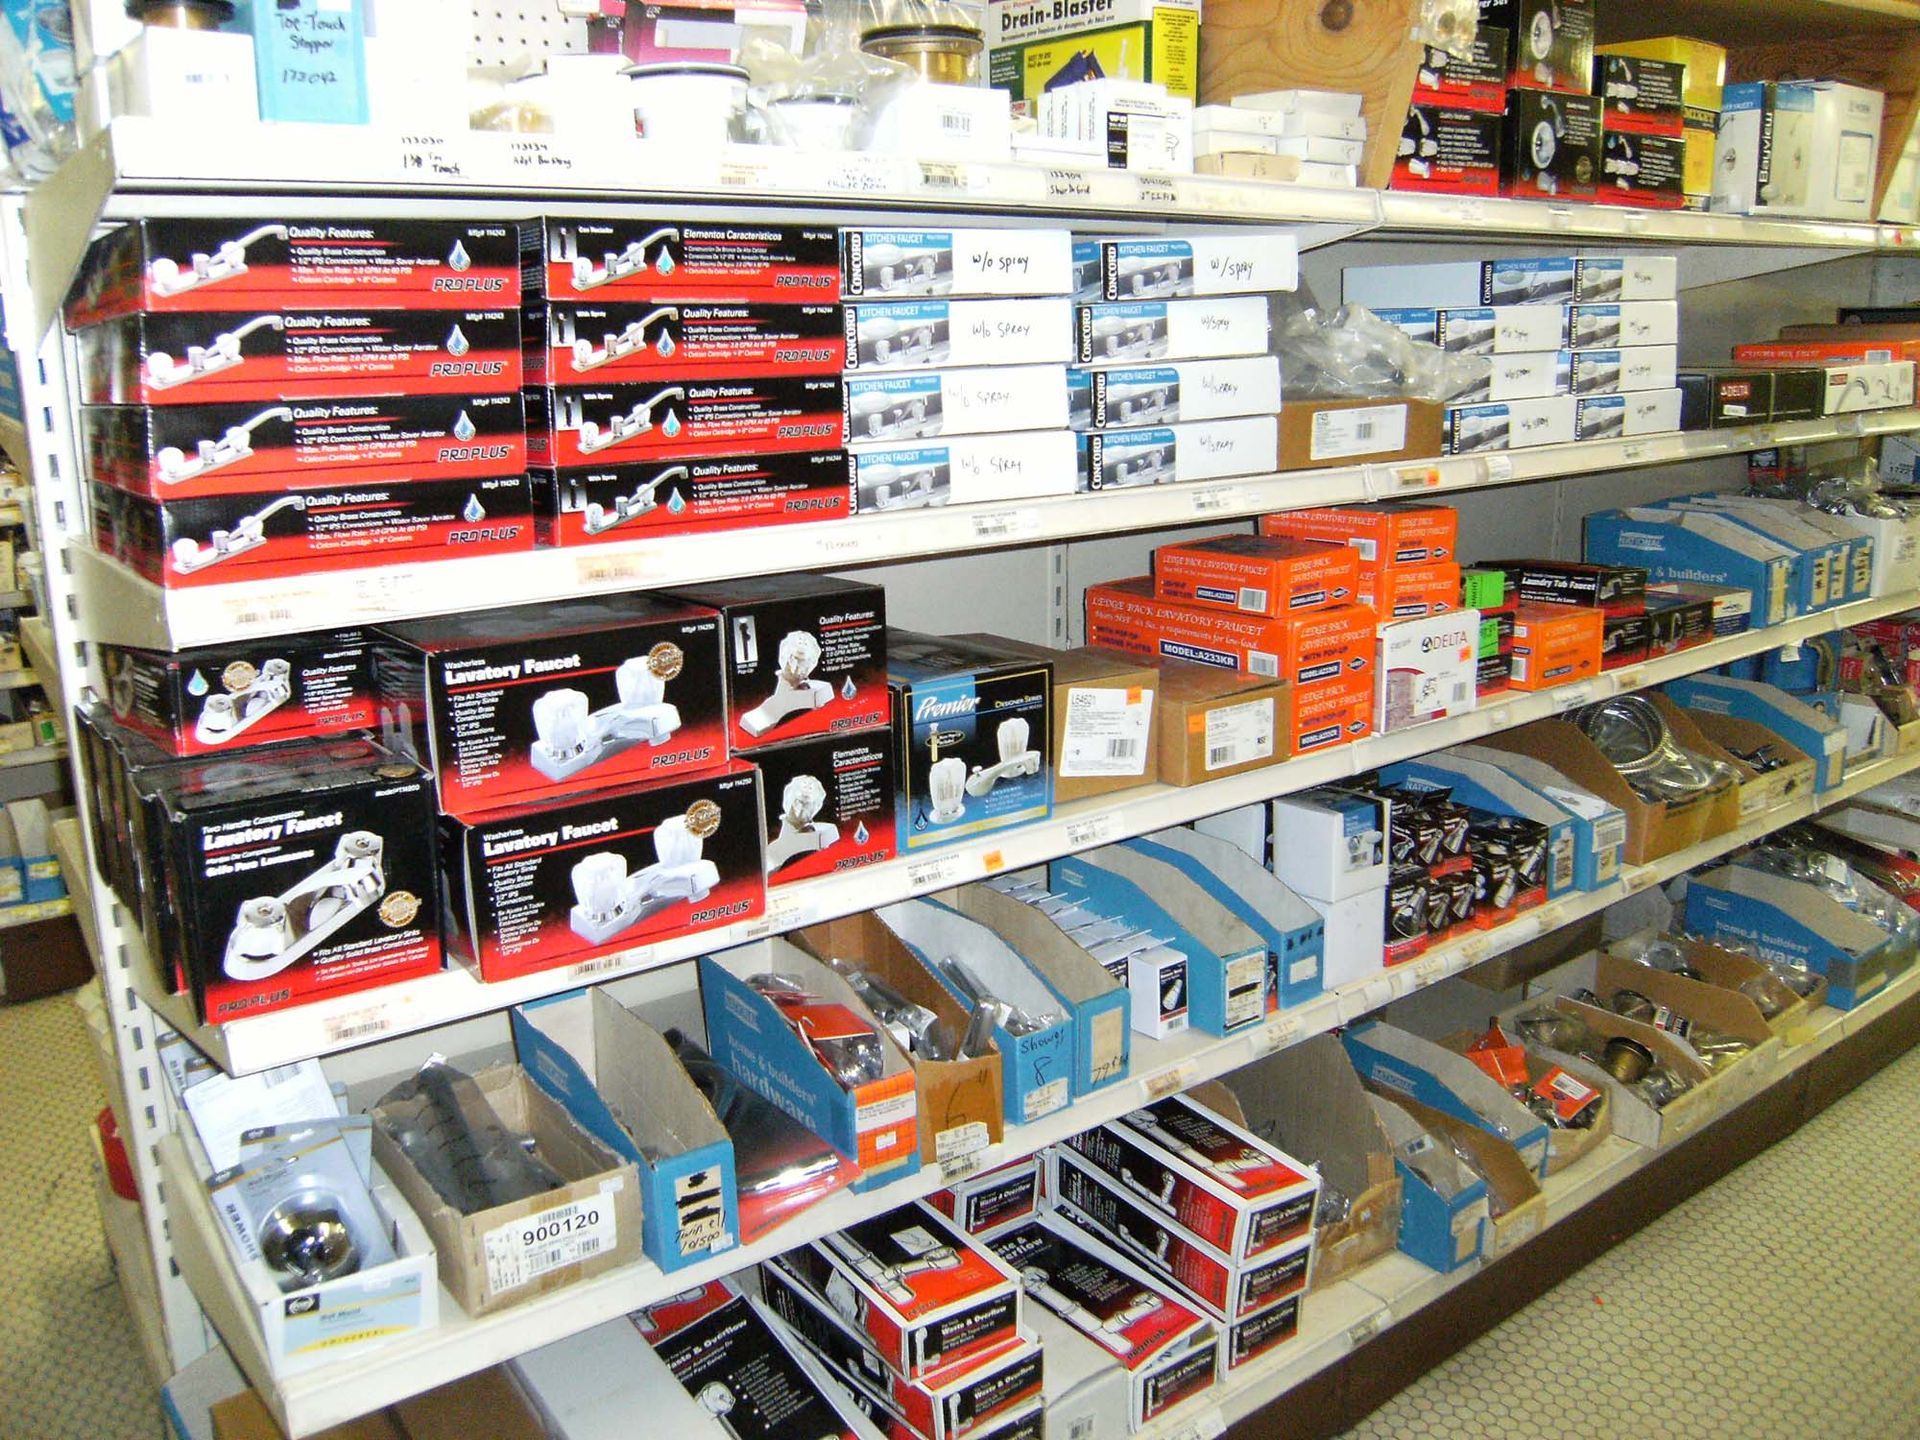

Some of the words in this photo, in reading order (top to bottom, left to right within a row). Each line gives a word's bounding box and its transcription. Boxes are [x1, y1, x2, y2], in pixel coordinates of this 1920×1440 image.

[289, 227, 326, 239] Quality
[328, 227, 374, 239] Features:
[684, 229, 726, 240] Elementos
[865, 234, 897, 243] KITCHEN
[898, 233, 923, 243] FAUCET
[297, 248, 322, 256] Quality
[1120, 245, 1146, 254] KITCHEN
[1147, 244, 1169, 253] FAUCET
[850, 233, 863, 295] CONCORD
[1107, 246, 1118, 299] CONCORD
[683, 308, 712, 319] Quality
[713, 308, 750, 318] Features:
[860, 308, 892, 317] KITCHEN
[893, 307, 919, 316] FAUCET
[284, 316, 322, 329] Quality
[324, 315, 371, 327] Features:
[293, 337, 318, 345] Quality
[845, 308, 858, 369] CONCORD
[1080, 308, 1092, 363] CONCORD
[1108, 373, 1134, 381] KITCHEN
[1135, 371, 1157, 380] FAUCET
[689, 387, 717, 399] Quality
[719, 387, 754, 397] Features:
[852, 381, 884, 392] KITCHEN
[885, 380, 912, 389] FAUCET
[1096, 374, 1106, 428] CONCORD
[293, 406, 331, 419] Quality
[333, 406, 379, 417] Features:
[693, 405, 712, 414] Quality
[302, 427, 326, 435] Quality
[328, 426, 347, 434] Brass
[348, 425, 391, 433] Construction
[1104, 435, 1129, 444] KITCHEN
[1130, 433, 1152, 442] FAUCET
[859, 453, 892, 463] KITCHEN
[893, 452, 919, 461] FAUCET
[1091, 438, 1102, 490] CONCORD
[692, 465, 722, 477] Quality
[723, 463, 759, 474] Features:
[698, 482, 717, 492] Quality
[306, 493, 342, 507] Quality
[344, 492, 390, 504] Features:
[314, 514, 339, 523] Quality
[340, 512, 359, 521] Brass
[359, 510, 402, 520] Construction
[1522, 576, 1552, 588] Laundry
[1554, 578, 1569, 588] Tub
[1569, 580, 1596, 591] Faucet
[819, 614, 844, 625] Quality
[844, 611, 875, 622] Features:
[1156, 608, 1213, 627] LAVATORY
[1216, 619, 1267, 637] FAUCET
[1433, 631, 1468, 650] DELTA
[1164, 644, 1235, 667] MODEL:A233KR
[444, 658, 486, 670] Washerless
[446, 662, 520, 685] Lavatory
[523, 654, 581, 676] Faucet
[302, 666, 326, 678] Quality
[916, 695, 982, 721] Premier
[832, 746, 870, 760] Elementos
[202, 826, 222, 835] Two
[222, 819, 252, 831] Handle
[252, 810, 305, 826] Compression
[203, 824, 283, 851] Lavatory
[285, 811, 344, 835] Faucet
[483, 828, 524, 842] Washerless
[484, 831, 559, 857] Lavatory
[561, 817, 619, 842] Faucet
[1716, 920, 1746, 935] home
[318, 947, 332, 958] Fits
[332, 943, 343, 954] All
[343, 939, 373, 953] Standard
[373, 933, 404, 948] Lavatory
[403, 929, 421, 940] Sinks
[319, 953, 345, 966] Quality
[345, 949, 364, 960] Solid
[364, 946, 383, 957] Brass
[383, 935, 425, 952] Construction
[730, 1050, 817, 1132] hardware
[522, 1209, 600, 1246] 900120
[941, 1322, 966, 1335] Waste
[974, 1306, 1008, 1323] Overflow
